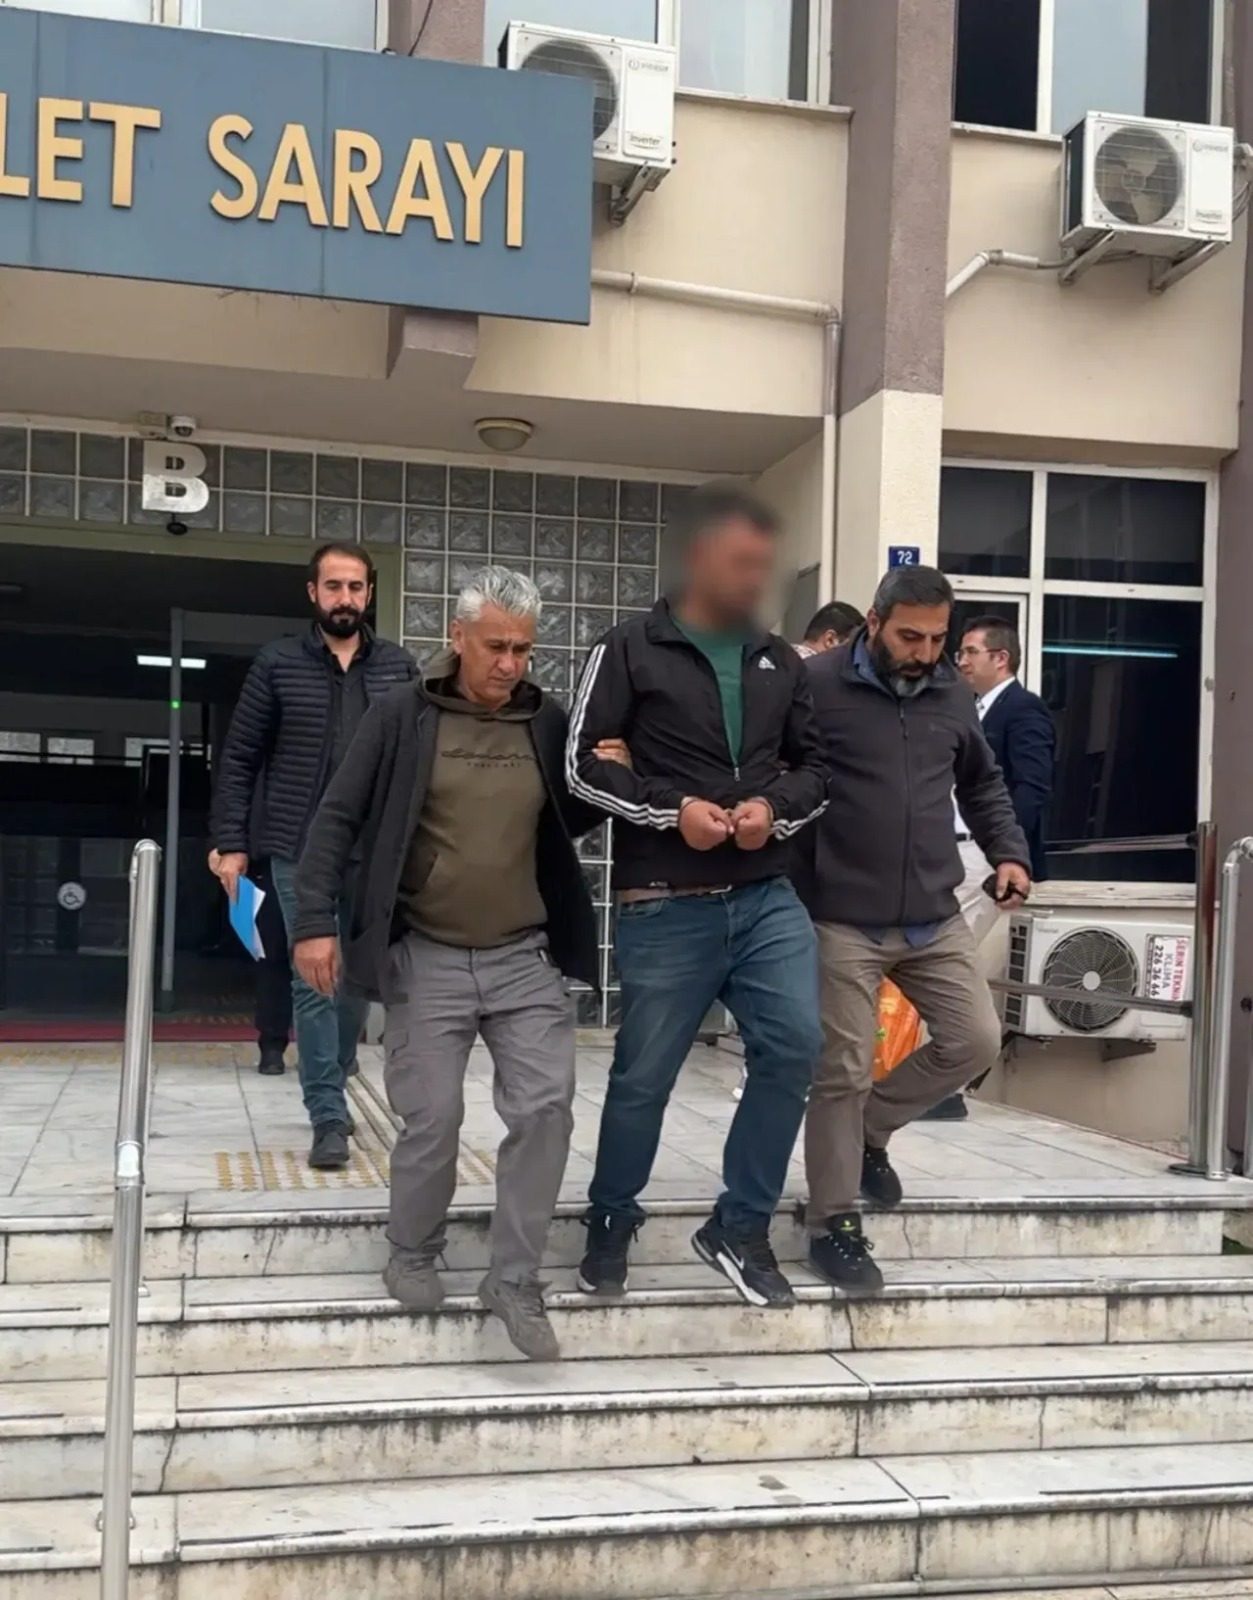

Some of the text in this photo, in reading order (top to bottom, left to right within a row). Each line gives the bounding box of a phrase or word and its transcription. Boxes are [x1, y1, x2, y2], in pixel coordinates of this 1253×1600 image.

[0, 92, 525, 248] LET SARAYI
[142, 440, 210, 513] B
[897, 550, 913, 565] 72
